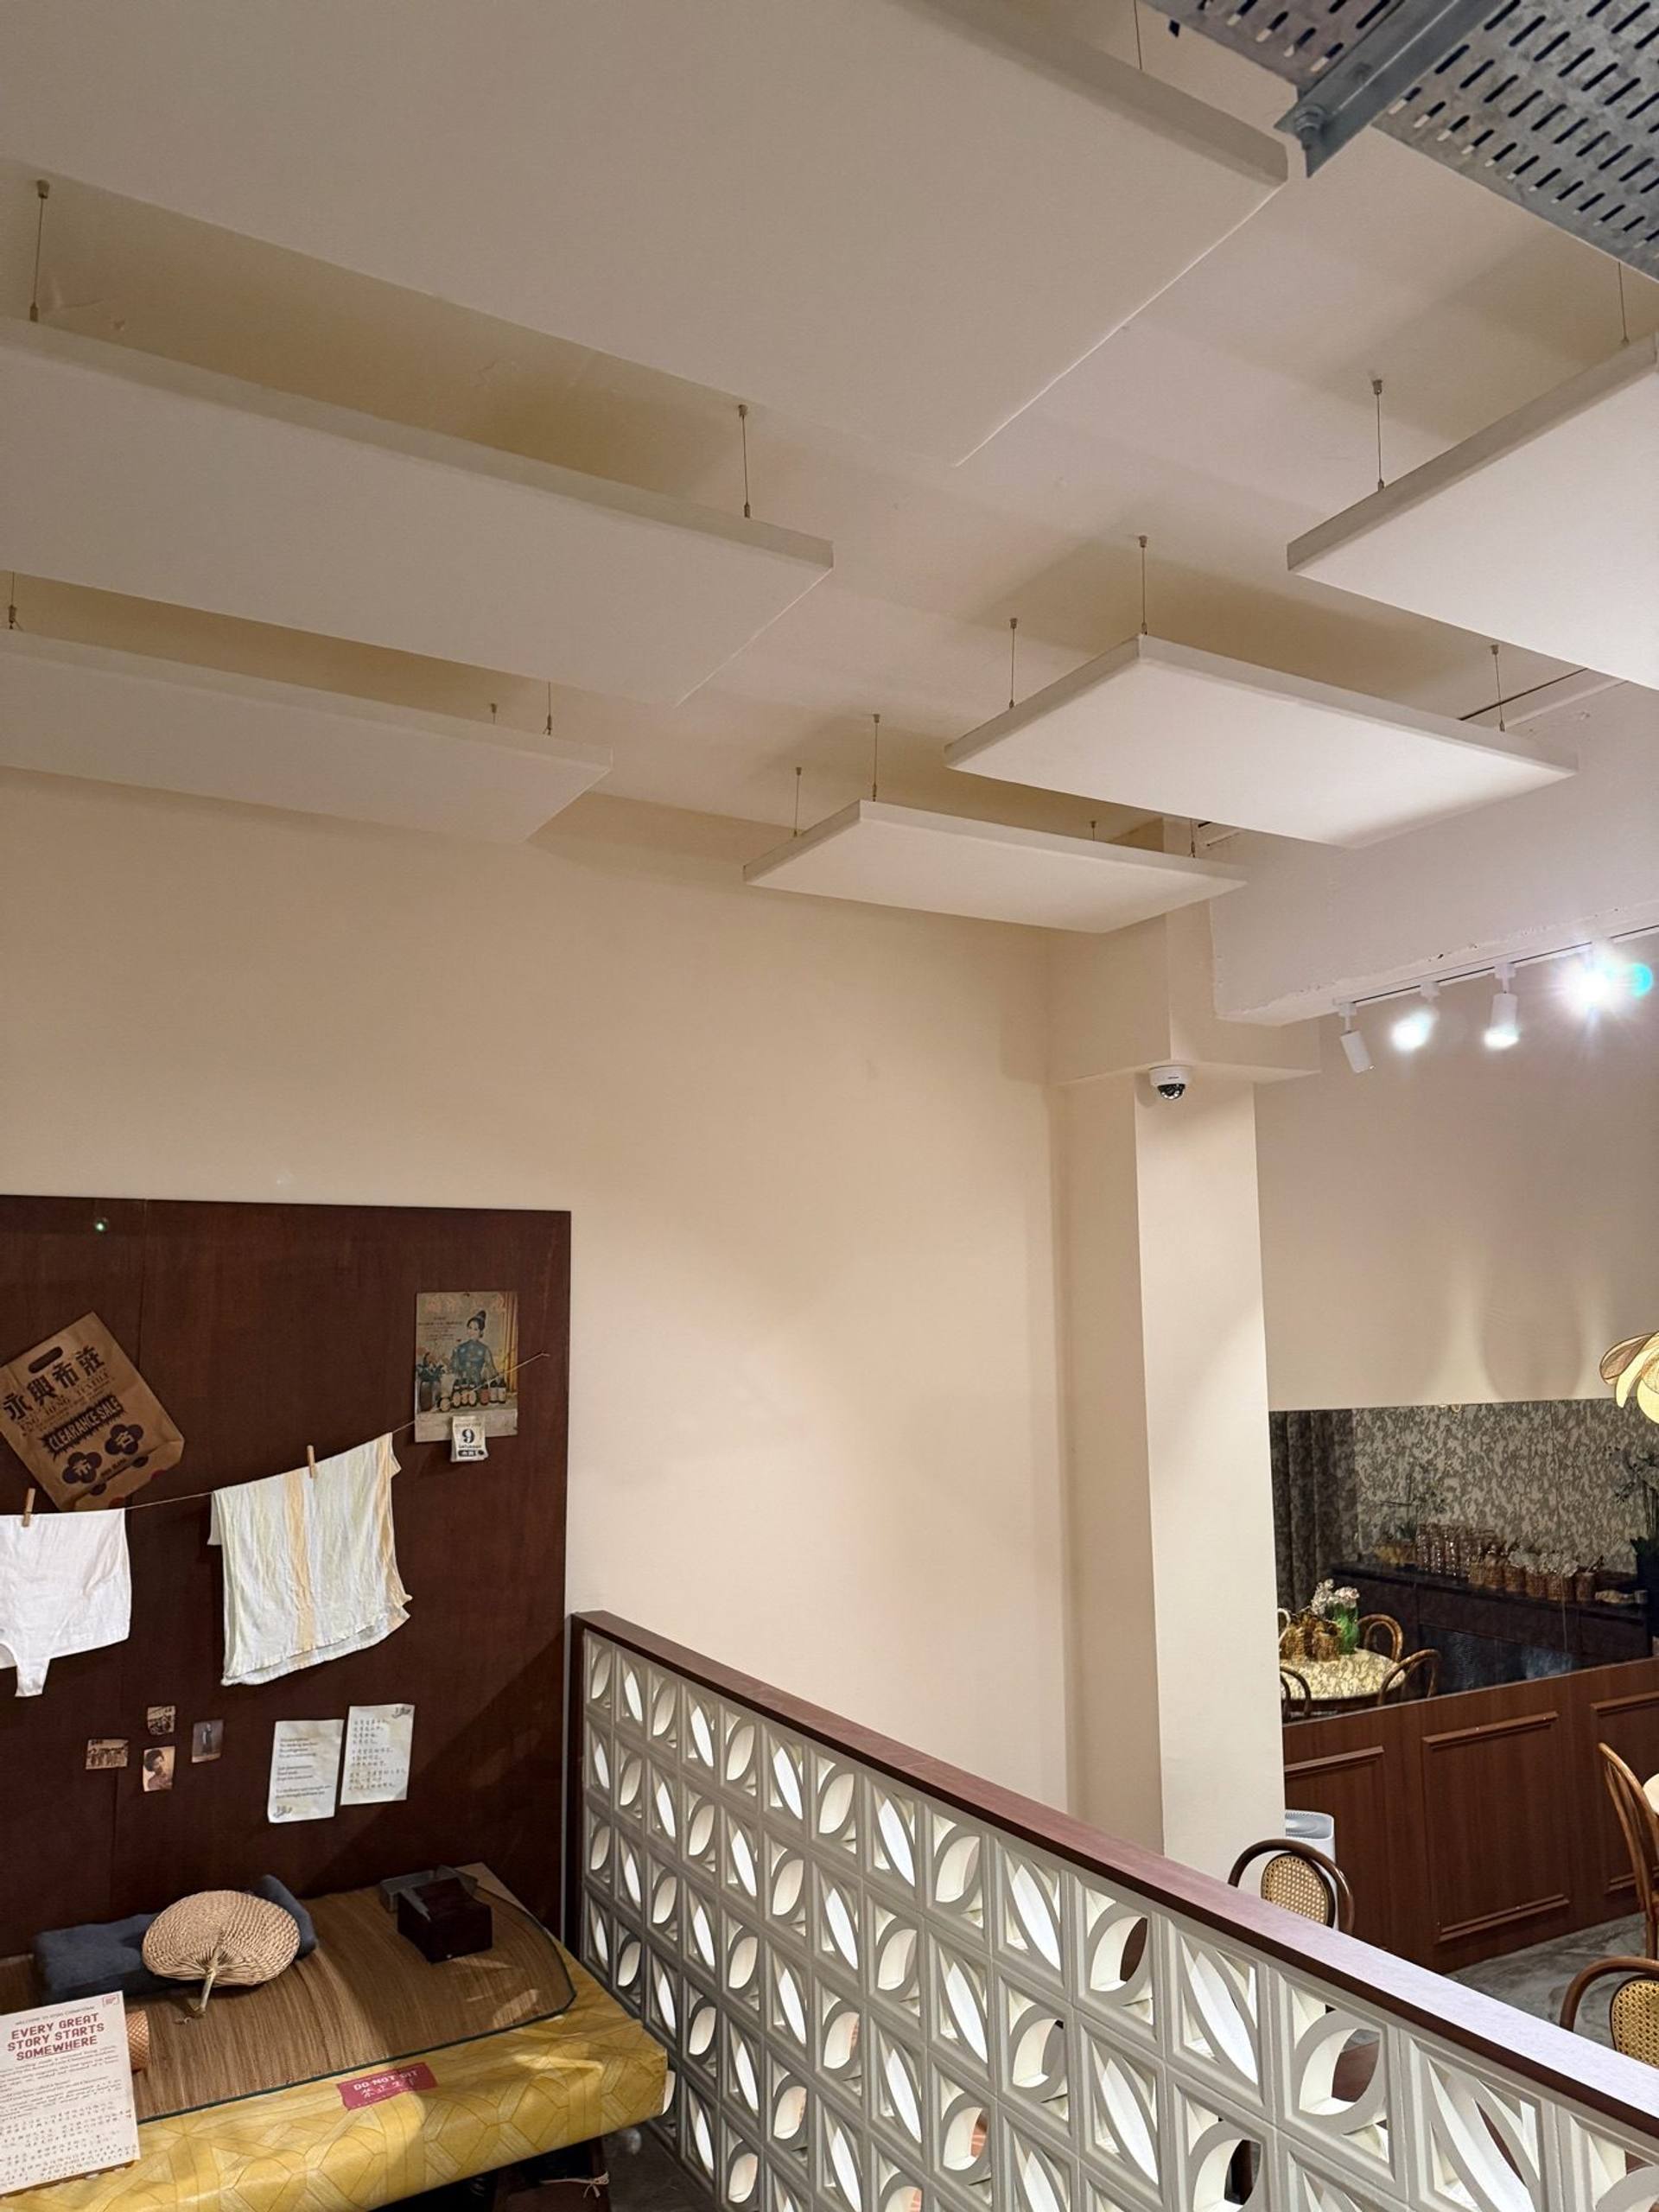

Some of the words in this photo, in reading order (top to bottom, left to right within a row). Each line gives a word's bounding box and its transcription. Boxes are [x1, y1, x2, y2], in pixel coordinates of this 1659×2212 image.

[48, 1412, 100, 1451] CLEARANCE
[99, 1395, 124, 1421] SALE
[461, 1428, 476, 1444] 9
[7, 2034, 50, 2052] STORY
[54, 2023, 105, 2042] STARTS
[11, 2022, 54, 2040] EVERY
[59, 2012, 99, 2029] GREAT
[16, 2035, 98, 2062] SOMEWHERE
[353, 2082, 370, 2091] DO
[372, 2075, 396, 2086] NOT
